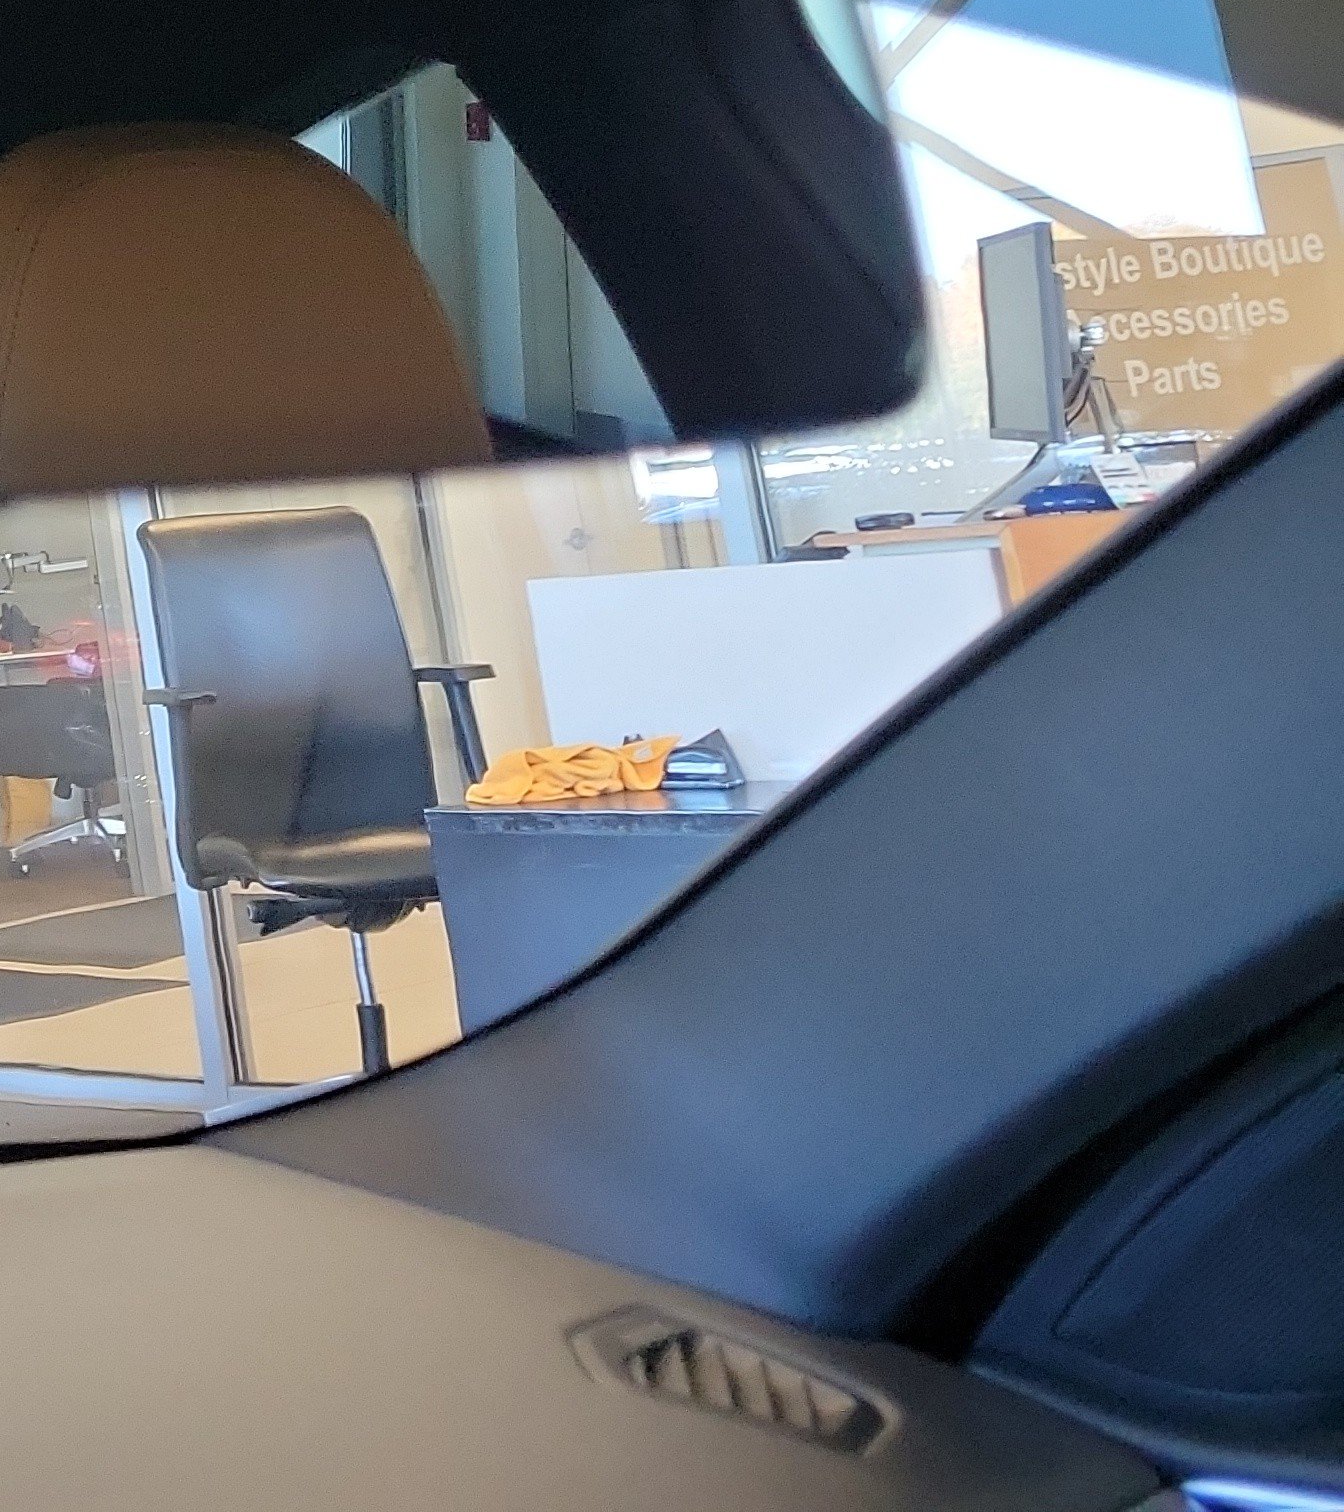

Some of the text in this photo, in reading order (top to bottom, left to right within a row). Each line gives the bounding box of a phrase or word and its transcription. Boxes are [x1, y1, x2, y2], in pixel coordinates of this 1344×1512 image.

[1149, 232, 1325, 281] Boutique
[1066, 292, 1290, 342] cessories
[1124, 357, 1222, 398] Parts
